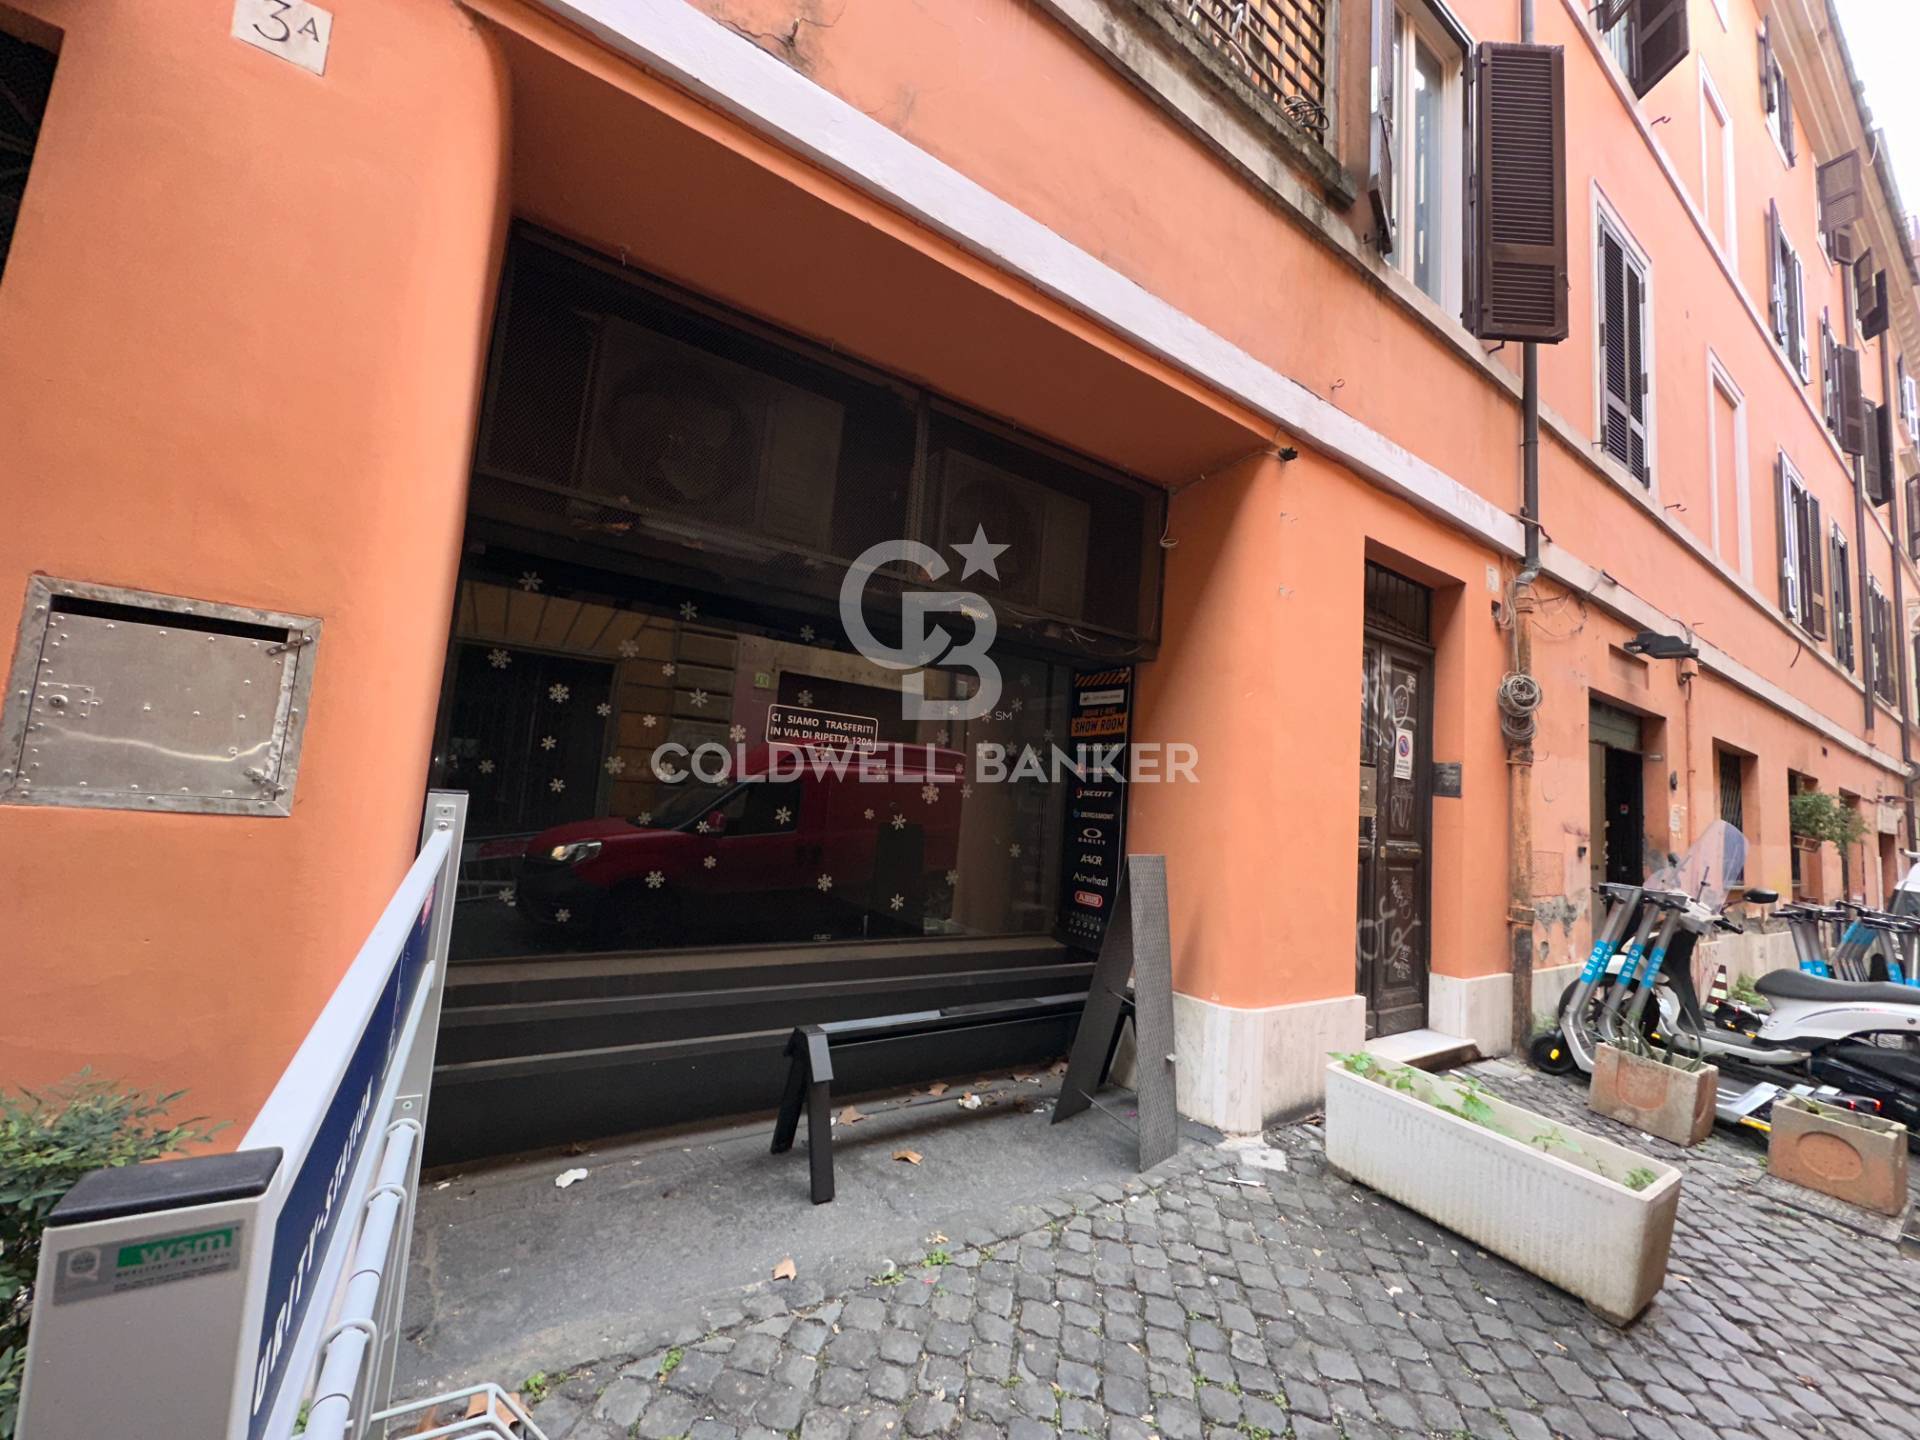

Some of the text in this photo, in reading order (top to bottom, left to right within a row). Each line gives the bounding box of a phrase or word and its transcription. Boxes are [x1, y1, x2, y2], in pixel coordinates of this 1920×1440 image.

[252, 0, 319, 42] 3A
[771, 713, 874, 734] CI SIAMO TRASFERITI
[1074, 718, 1125, 733] SHOW ROOM
[770, 726, 873, 746] IN VIA DI RIPETTA 120A
[1082, 790, 1114, 798] SCOTT
[1072, 871, 1109, 887] Airwheel
[1584, 946, 1603, 976] BIRD
[1622, 949, 1639, 978] BIRD
[141, 1234, 226, 1262] wsm
